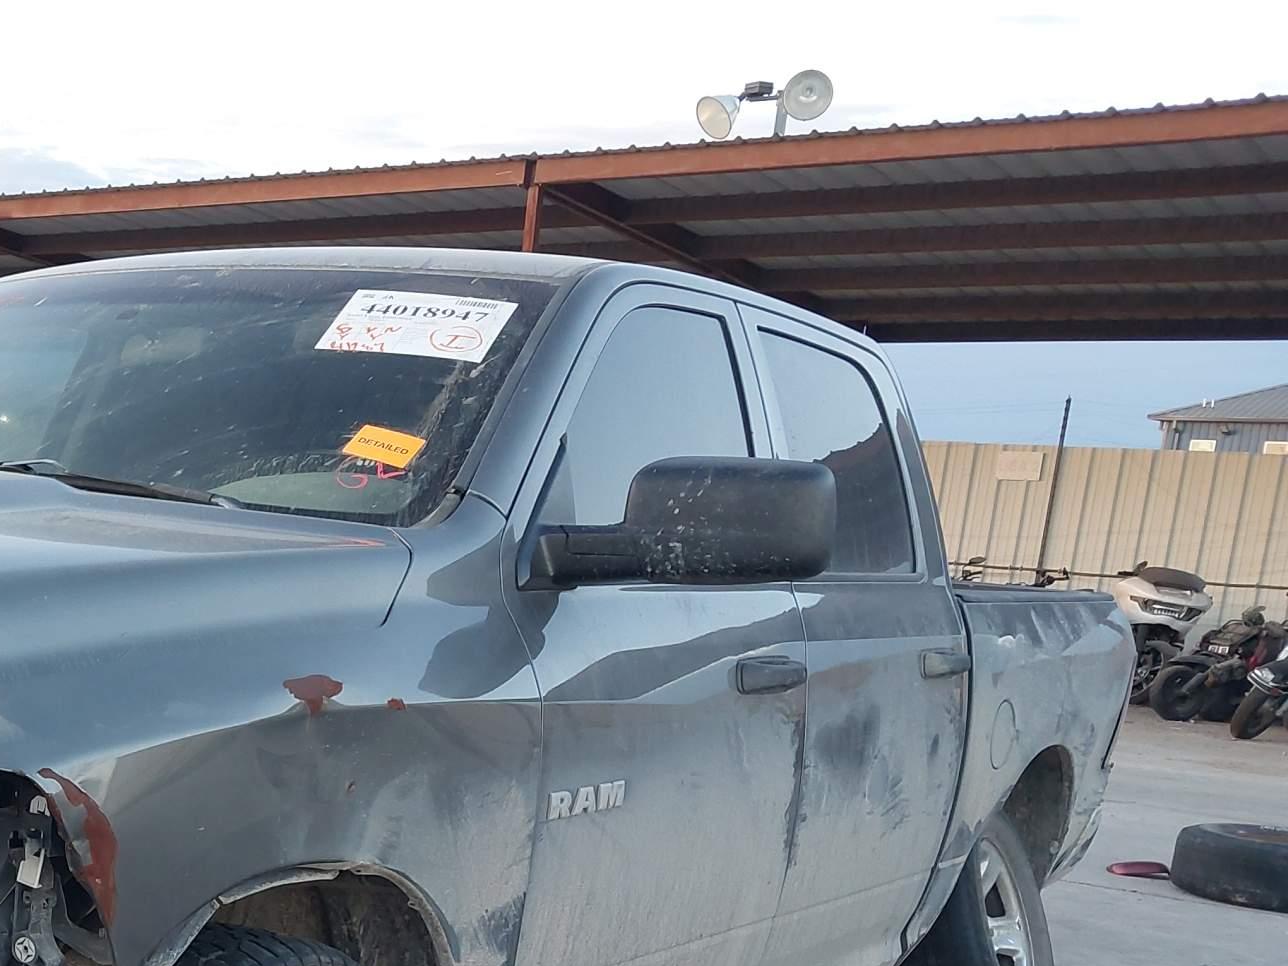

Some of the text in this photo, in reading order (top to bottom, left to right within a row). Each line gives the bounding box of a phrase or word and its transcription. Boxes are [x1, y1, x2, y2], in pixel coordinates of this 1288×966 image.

[360, 303, 489, 323] 44018947
[357, 436, 409, 455] DETAILED
[546, 779, 626, 820] RAM
